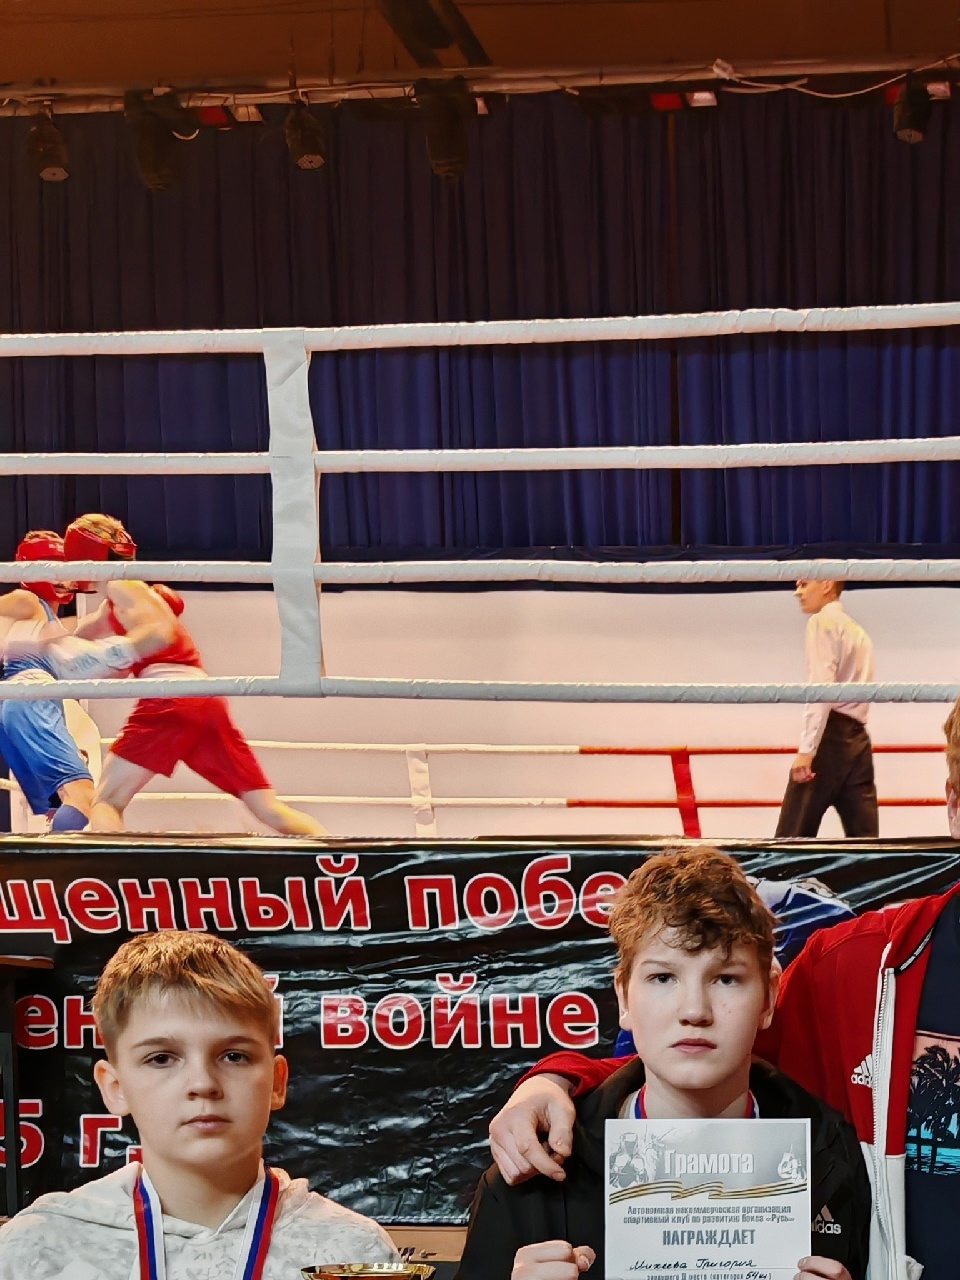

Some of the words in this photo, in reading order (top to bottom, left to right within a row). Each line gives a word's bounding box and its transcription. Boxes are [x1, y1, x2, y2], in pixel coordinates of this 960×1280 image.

[320, 974, 599, 1049] войне
[664, 1150, 755, 1178] Грамота
[671, 1215, 690, 1224] клуб
[663, 1229, 755, 1248] НАГРАЖДАЕТ
